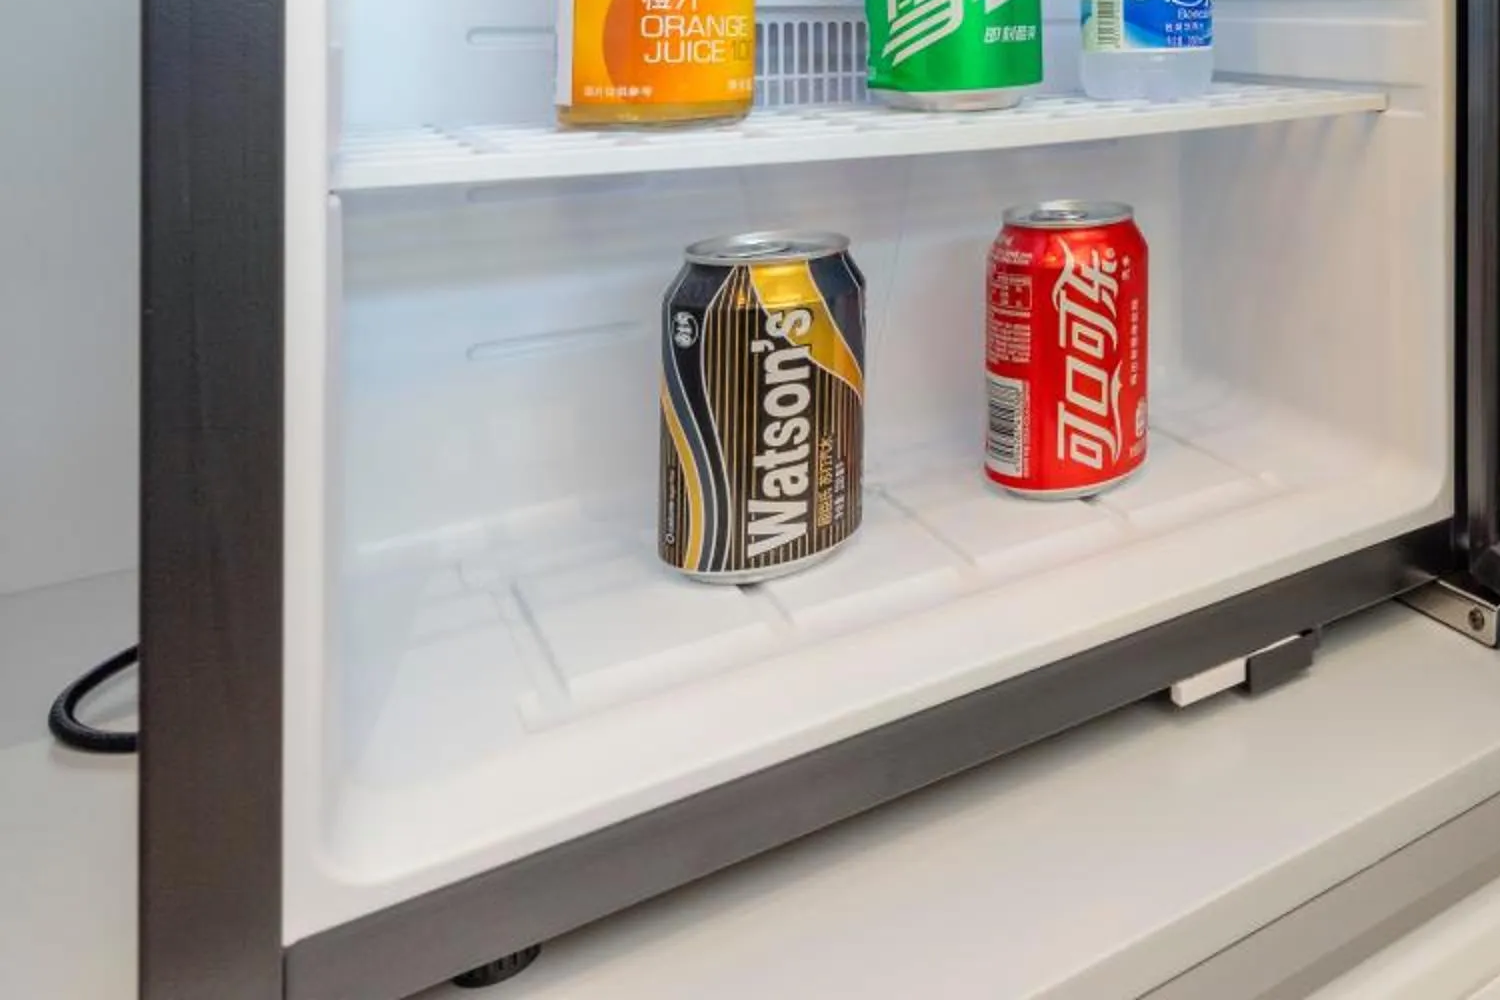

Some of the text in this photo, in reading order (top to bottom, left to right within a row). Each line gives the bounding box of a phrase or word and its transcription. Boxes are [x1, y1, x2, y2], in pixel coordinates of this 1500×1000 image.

[640, 14, 748, 38] ORANGE
[643, 39, 726, 64] JUICE
[1052, 237, 1123, 470] 可口可乐
[748, 307, 814, 559] Watson's
